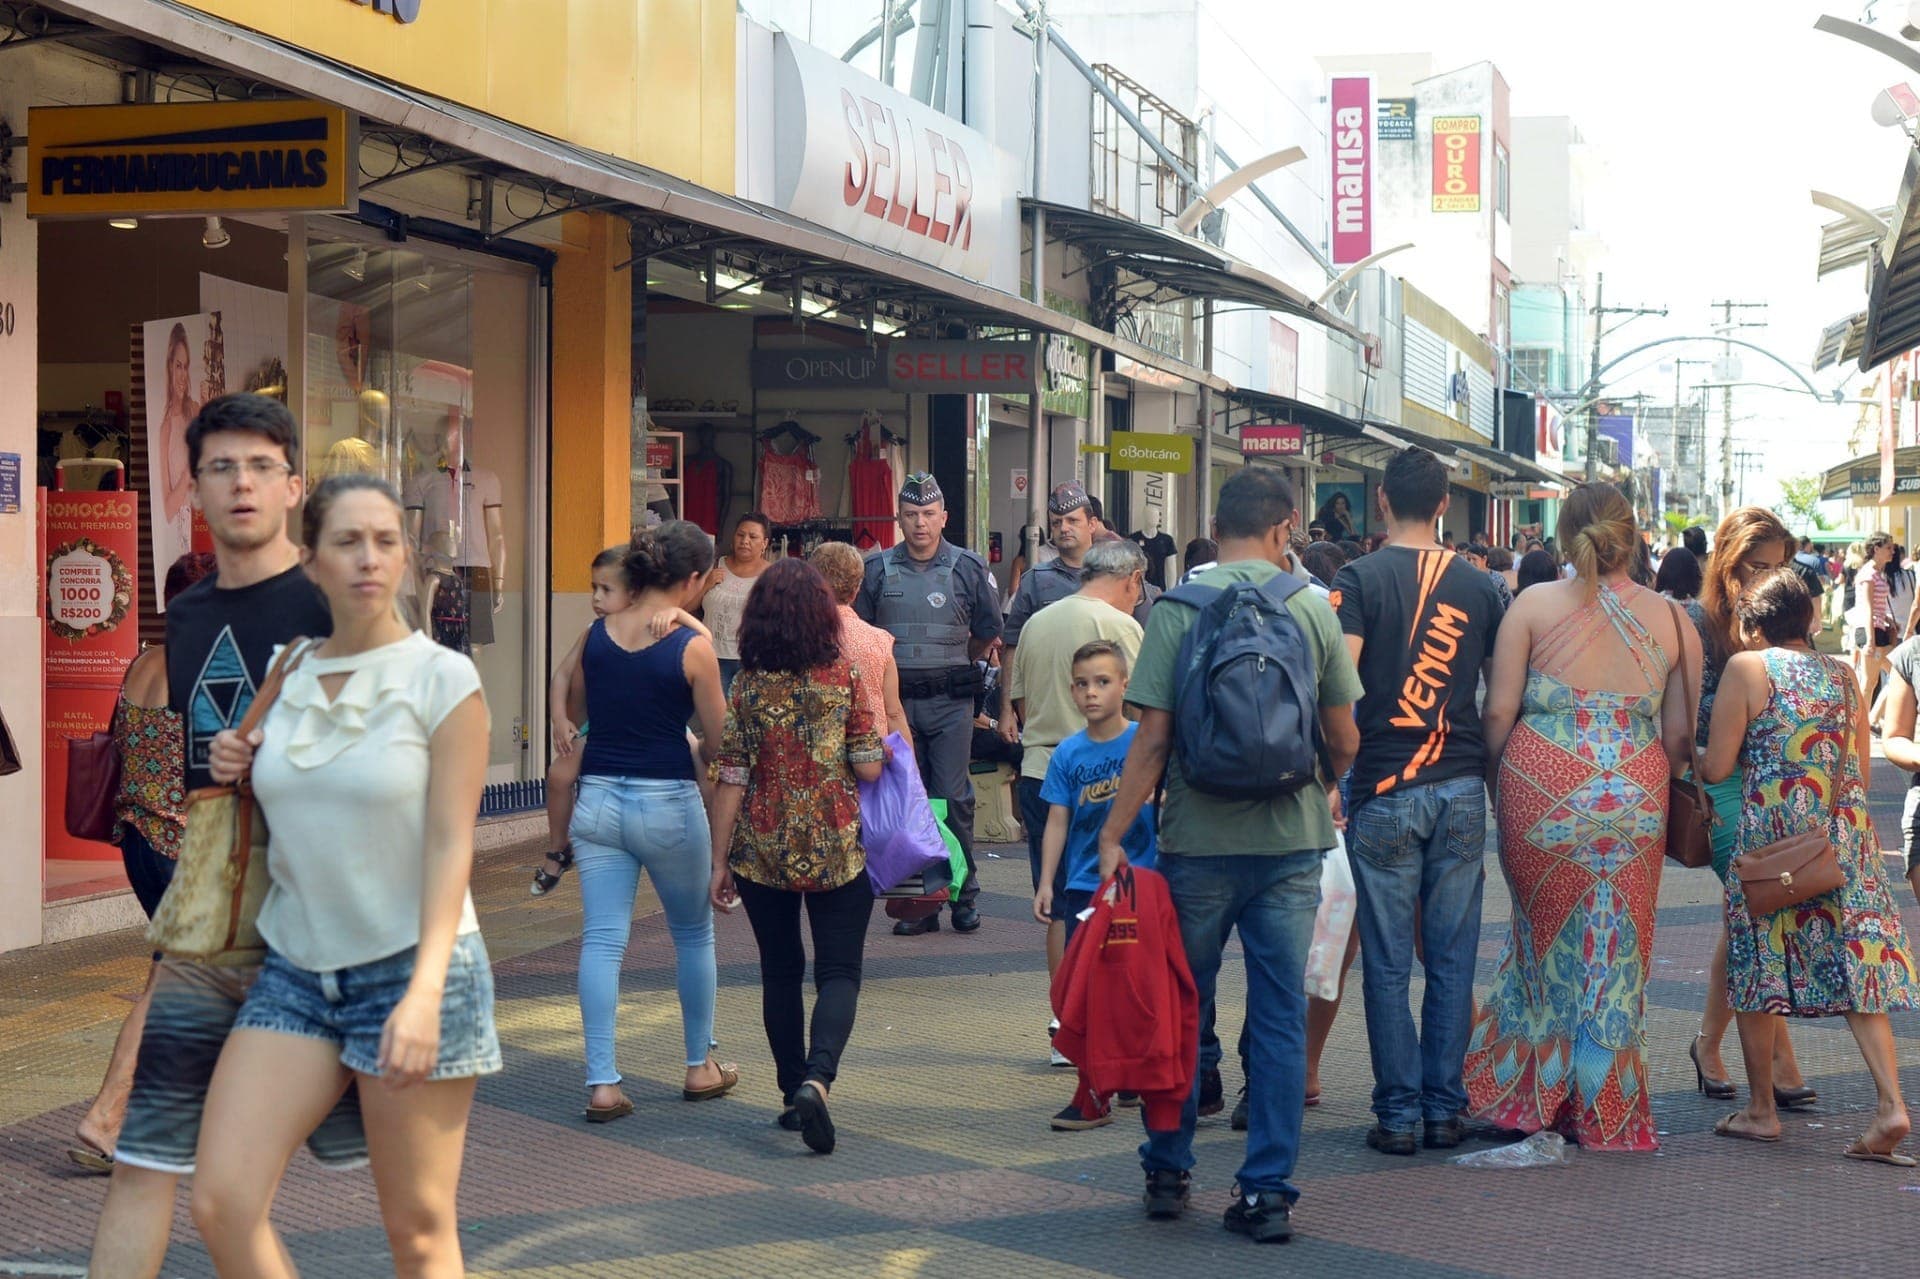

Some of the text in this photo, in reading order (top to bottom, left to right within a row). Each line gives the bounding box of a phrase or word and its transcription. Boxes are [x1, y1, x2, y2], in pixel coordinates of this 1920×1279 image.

[1378, 120, 1413, 128] VOCACIA
[1435, 119, 1477, 131] COMPRO
[841, 88, 974, 251] SELLER
[1337, 106, 1365, 233] marisa
[1445, 134, 1468, 194] OURO
[42, 149, 328, 195] PERNAMBUCANAS
[895, 353, 1029, 381] SELLER
[1242, 437, 1301, 450] marisa
[1119, 445, 1181, 460] oBoticário
[1144, 472, 1164, 506] TÊN
[1851, 481, 1880, 493] BIJOU
[46, 500, 132, 521] ROMOÇÃO
[80, 521, 132, 530] PREMIADO
[59, 568, 101, 576] COMPRE E
[59, 577, 102, 585] CONCORRA
[60, 587, 101, 601] 1000
[60, 607, 101, 619] R$200
[1388, 602, 1470, 727] VENUM
[63, 712, 94, 720] NATAL
[46, 720, 109, 730] ERNAMBUCAN
